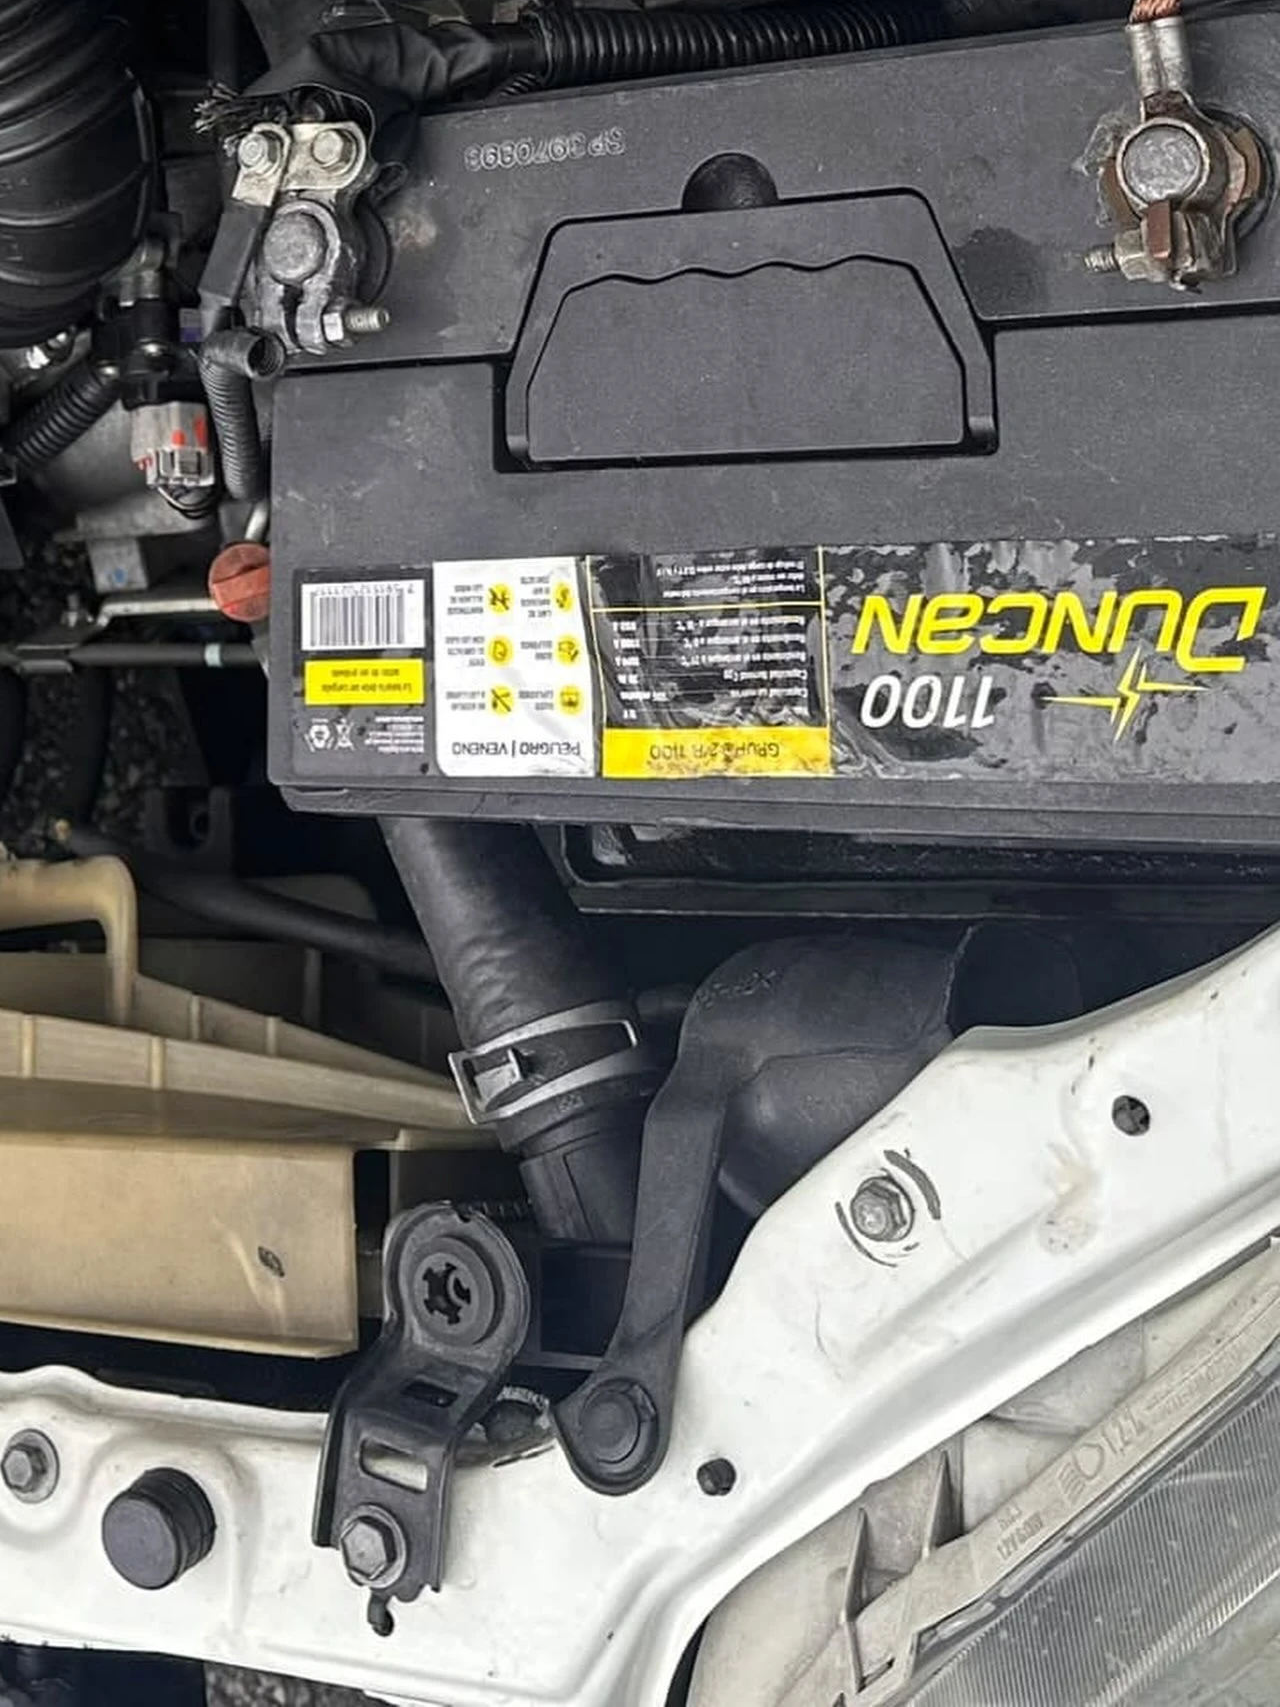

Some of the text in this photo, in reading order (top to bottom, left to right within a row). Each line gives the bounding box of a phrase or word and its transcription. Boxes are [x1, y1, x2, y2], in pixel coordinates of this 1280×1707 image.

[860, 675, 996, 730] 1100
[451, 741, 508, 756] VENENO
[519, 741, 581, 757] PELIGRO
